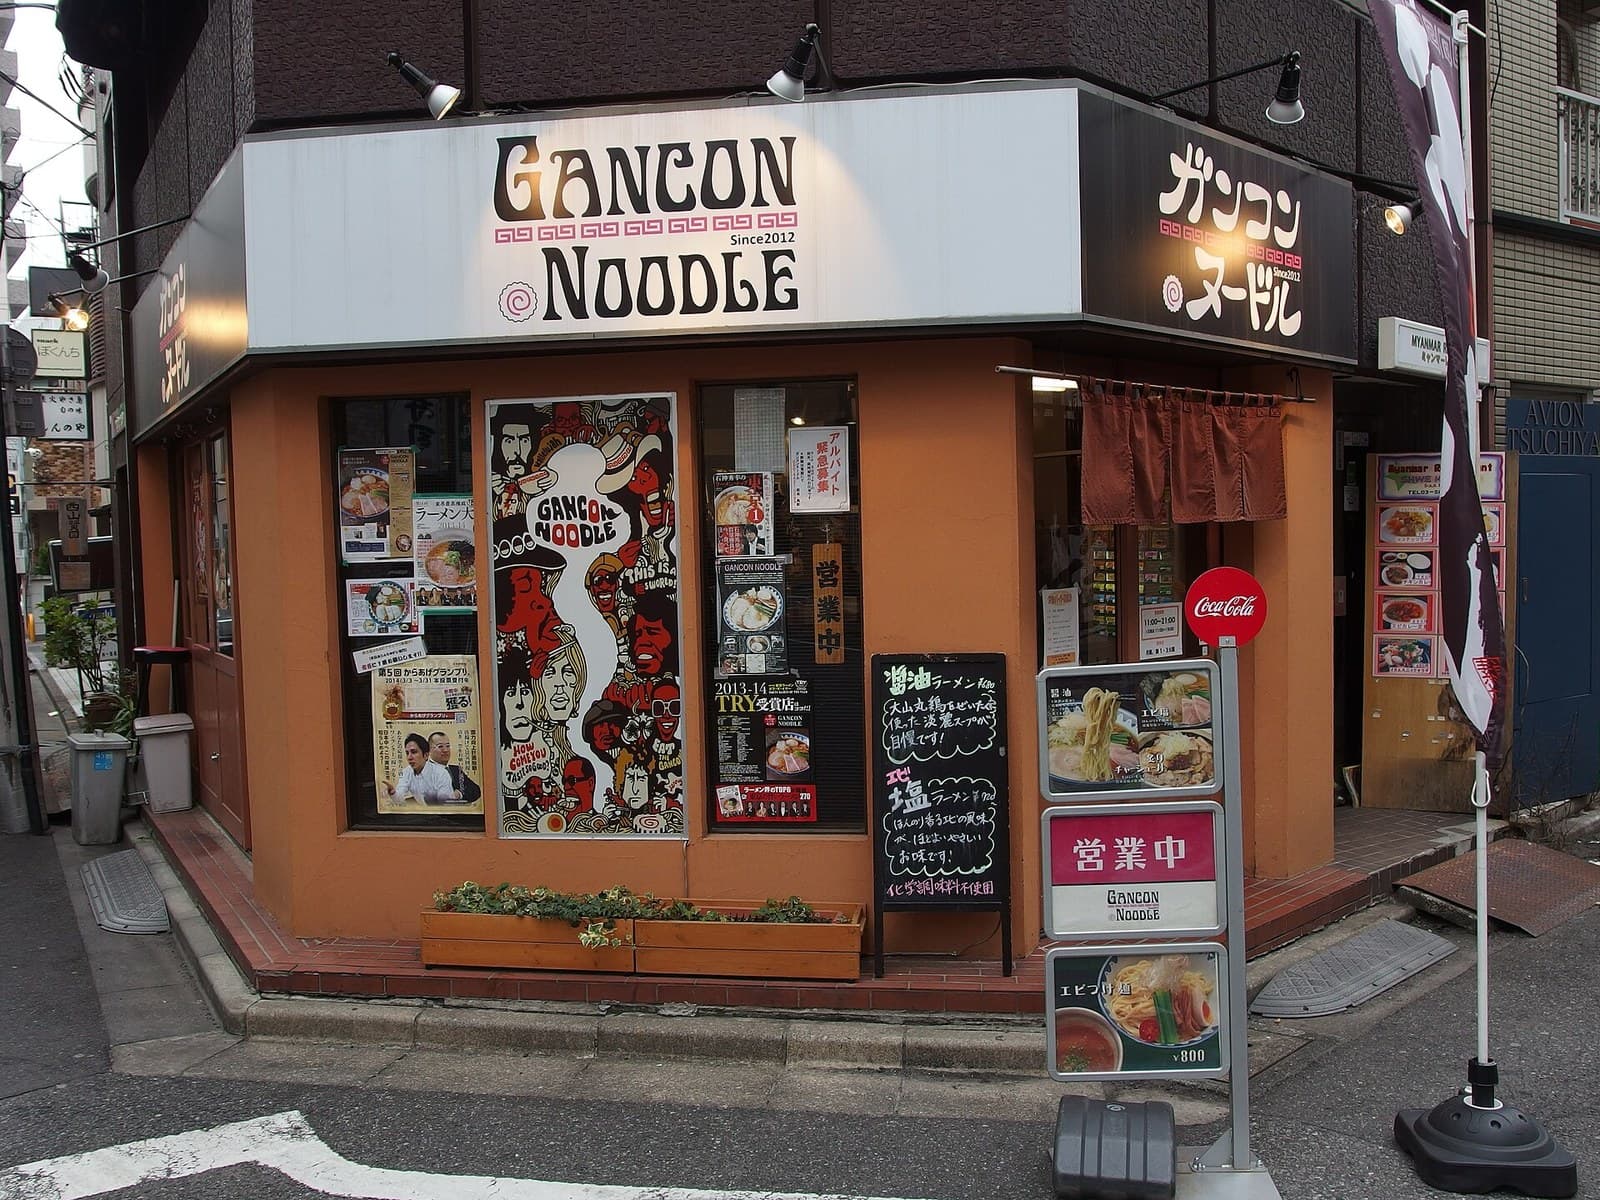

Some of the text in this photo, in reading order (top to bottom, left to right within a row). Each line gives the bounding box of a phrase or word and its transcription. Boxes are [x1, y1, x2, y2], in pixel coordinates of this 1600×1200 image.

[493, 135, 797, 222] GANCON
[1159, 142, 1301, 249] ガンコン
[730, 231, 796, 246] Since2012
[541, 246, 799, 321] NOODLE
[1185, 246, 1302, 337] ヌードル
[1411, 334, 1441, 352] MYANMAR
[1525, 399, 1585, 427] AVION
[1507, 427, 1600, 456] TSUCHIYA
[816, 441, 830, 494] 緊急募集
[829, 432, 841, 497] アルバイト
[537, 495, 622, 523] GANCON
[535, 521, 617, 548] NOODLE
[625, 565, 655, 584] THIS
[658, 561, 669, 574] IS
[724, 562, 784, 572] GANCON NOODLE
[815, 559, 841, 656] 営業中
[1194, 595, 1257, 618] Coca-Cola
[715, 681, 767, 695] 2013-14
[510, 747, 547, 771] COME YOU
[513, 742, 535, 757] HOW
[885, 766, 911, 786] エビ
[1073, 835, 1187, 872] 営業中
[887, 877, 994, 897] 化学調味料不使用
[1107, 889, 1159, 905] GANCON
[1116, 908, 1160, 921] NOODLE
[1060, 983, 1132, 997] エビつけ麺
[1173, 1049, 1206, 1063] ¥800
